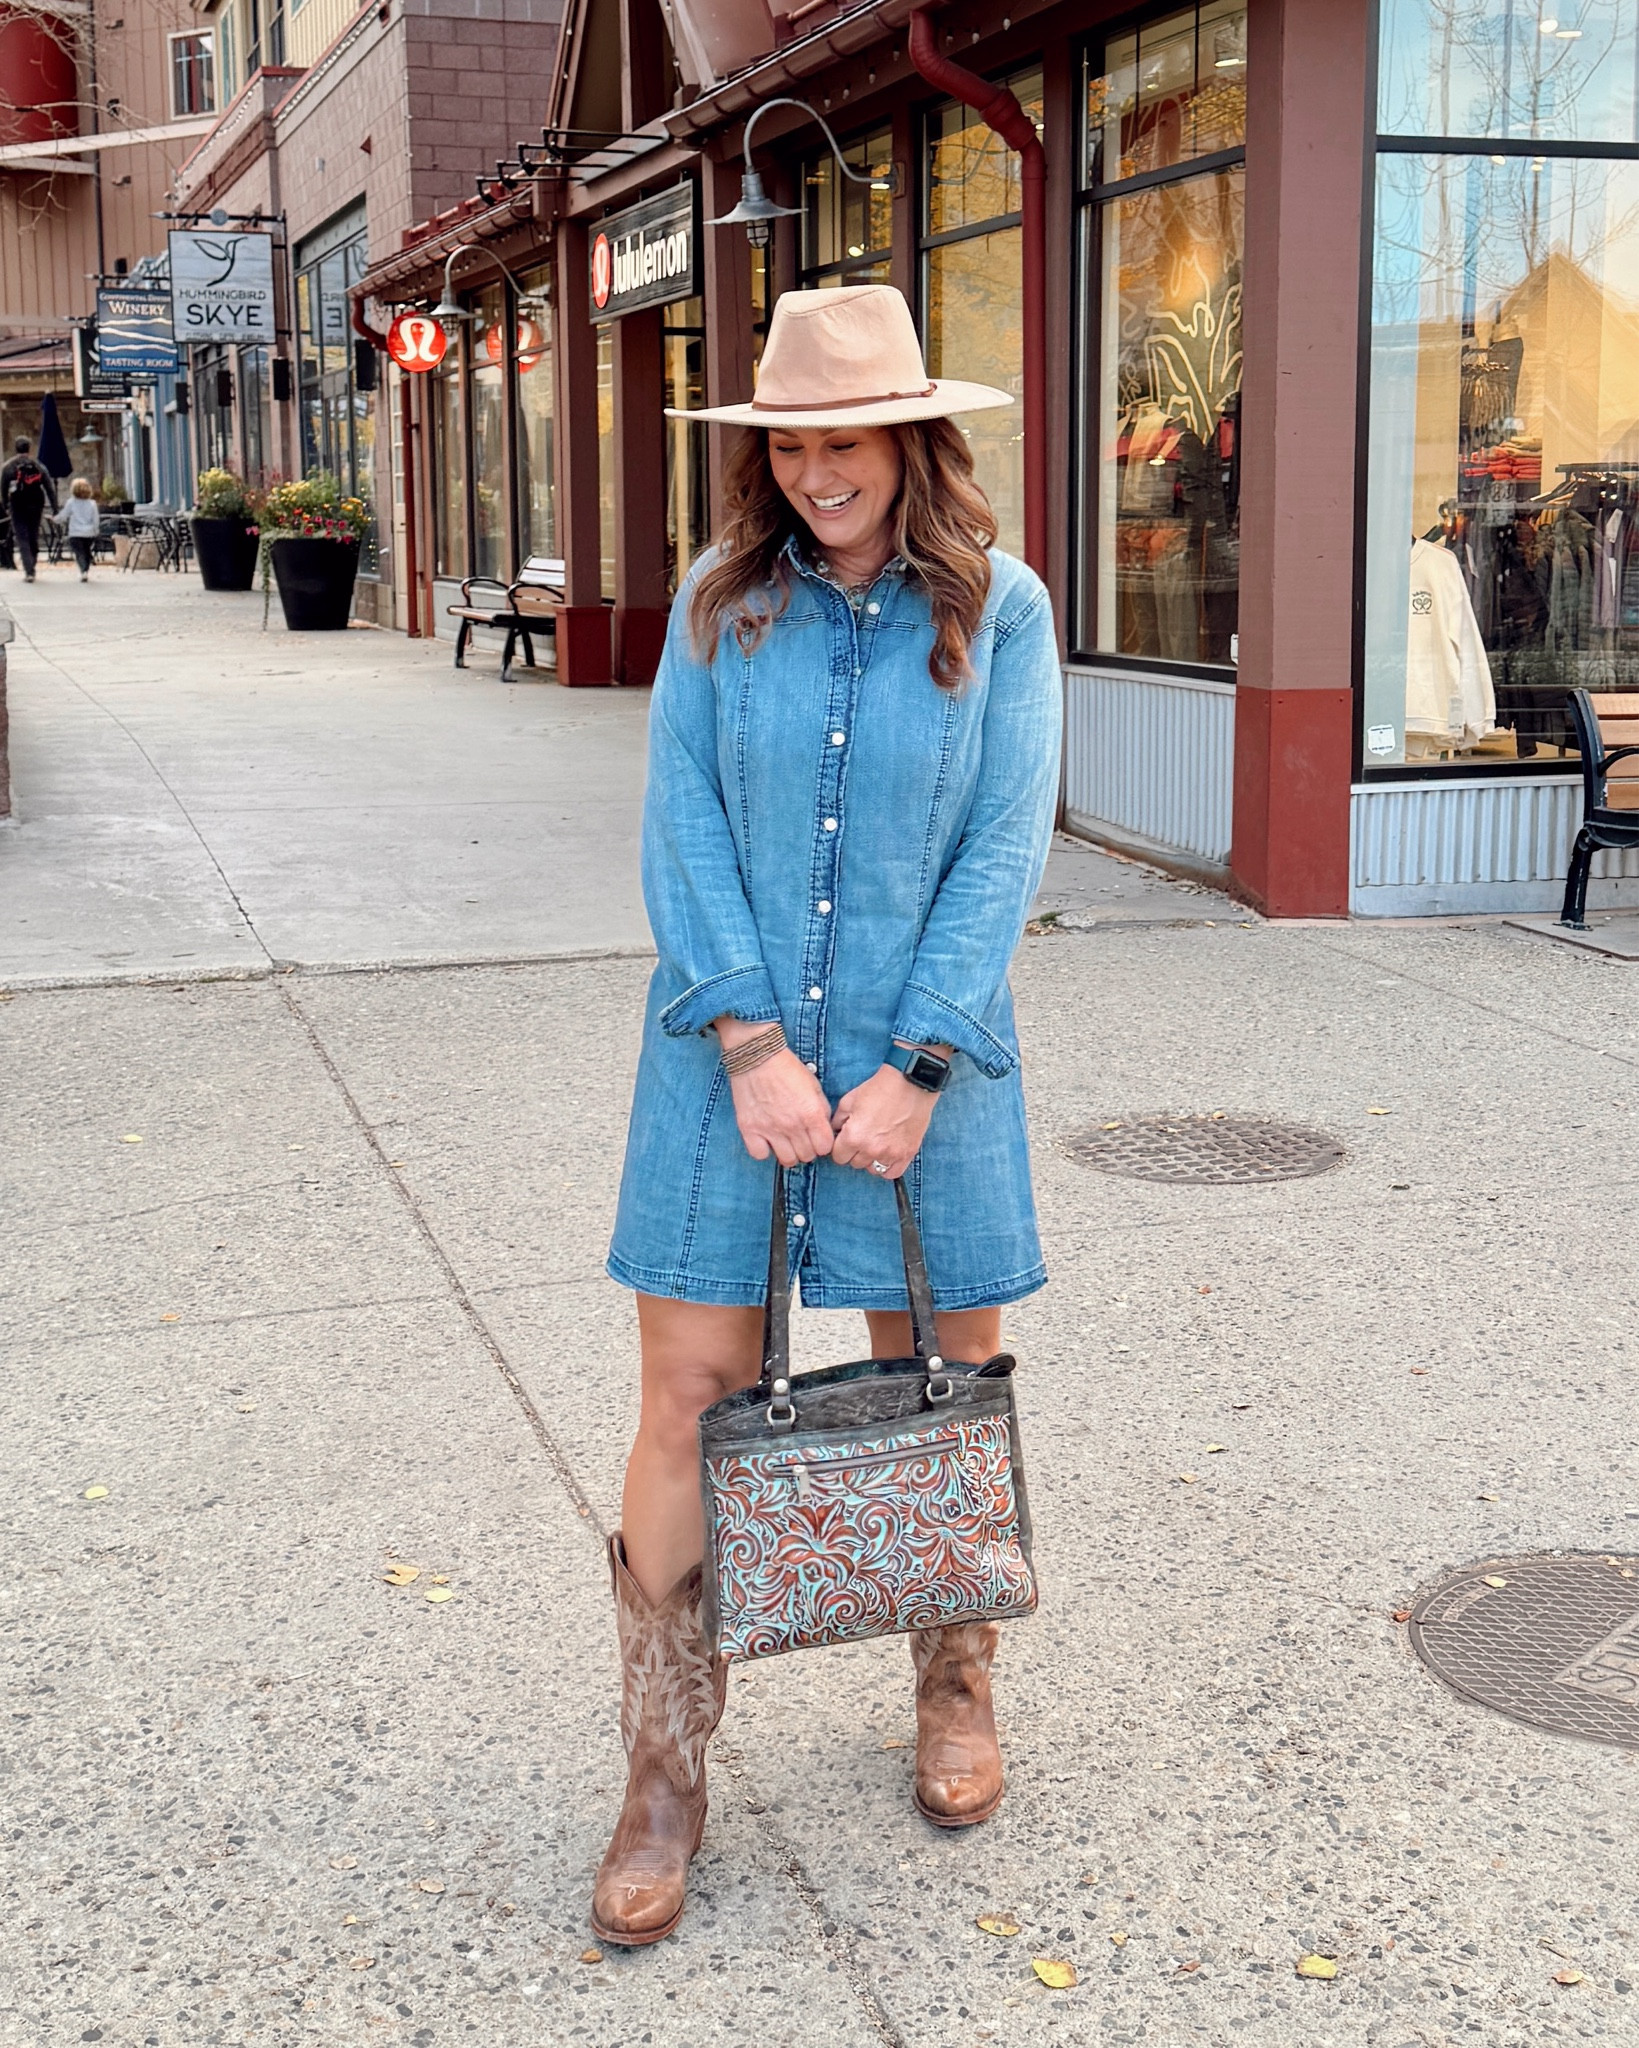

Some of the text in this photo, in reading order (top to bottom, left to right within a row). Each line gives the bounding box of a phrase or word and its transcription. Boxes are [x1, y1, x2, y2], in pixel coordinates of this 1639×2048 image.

[613, 230, 687, 295] lululemon
[179, 289, 266, 301] HUMMINGBIRD
[108, 301, 166, 316] WINERY
[186, 303, 263, 326] SKYE
[105, 358, 173, 368] TASTING ROOM
